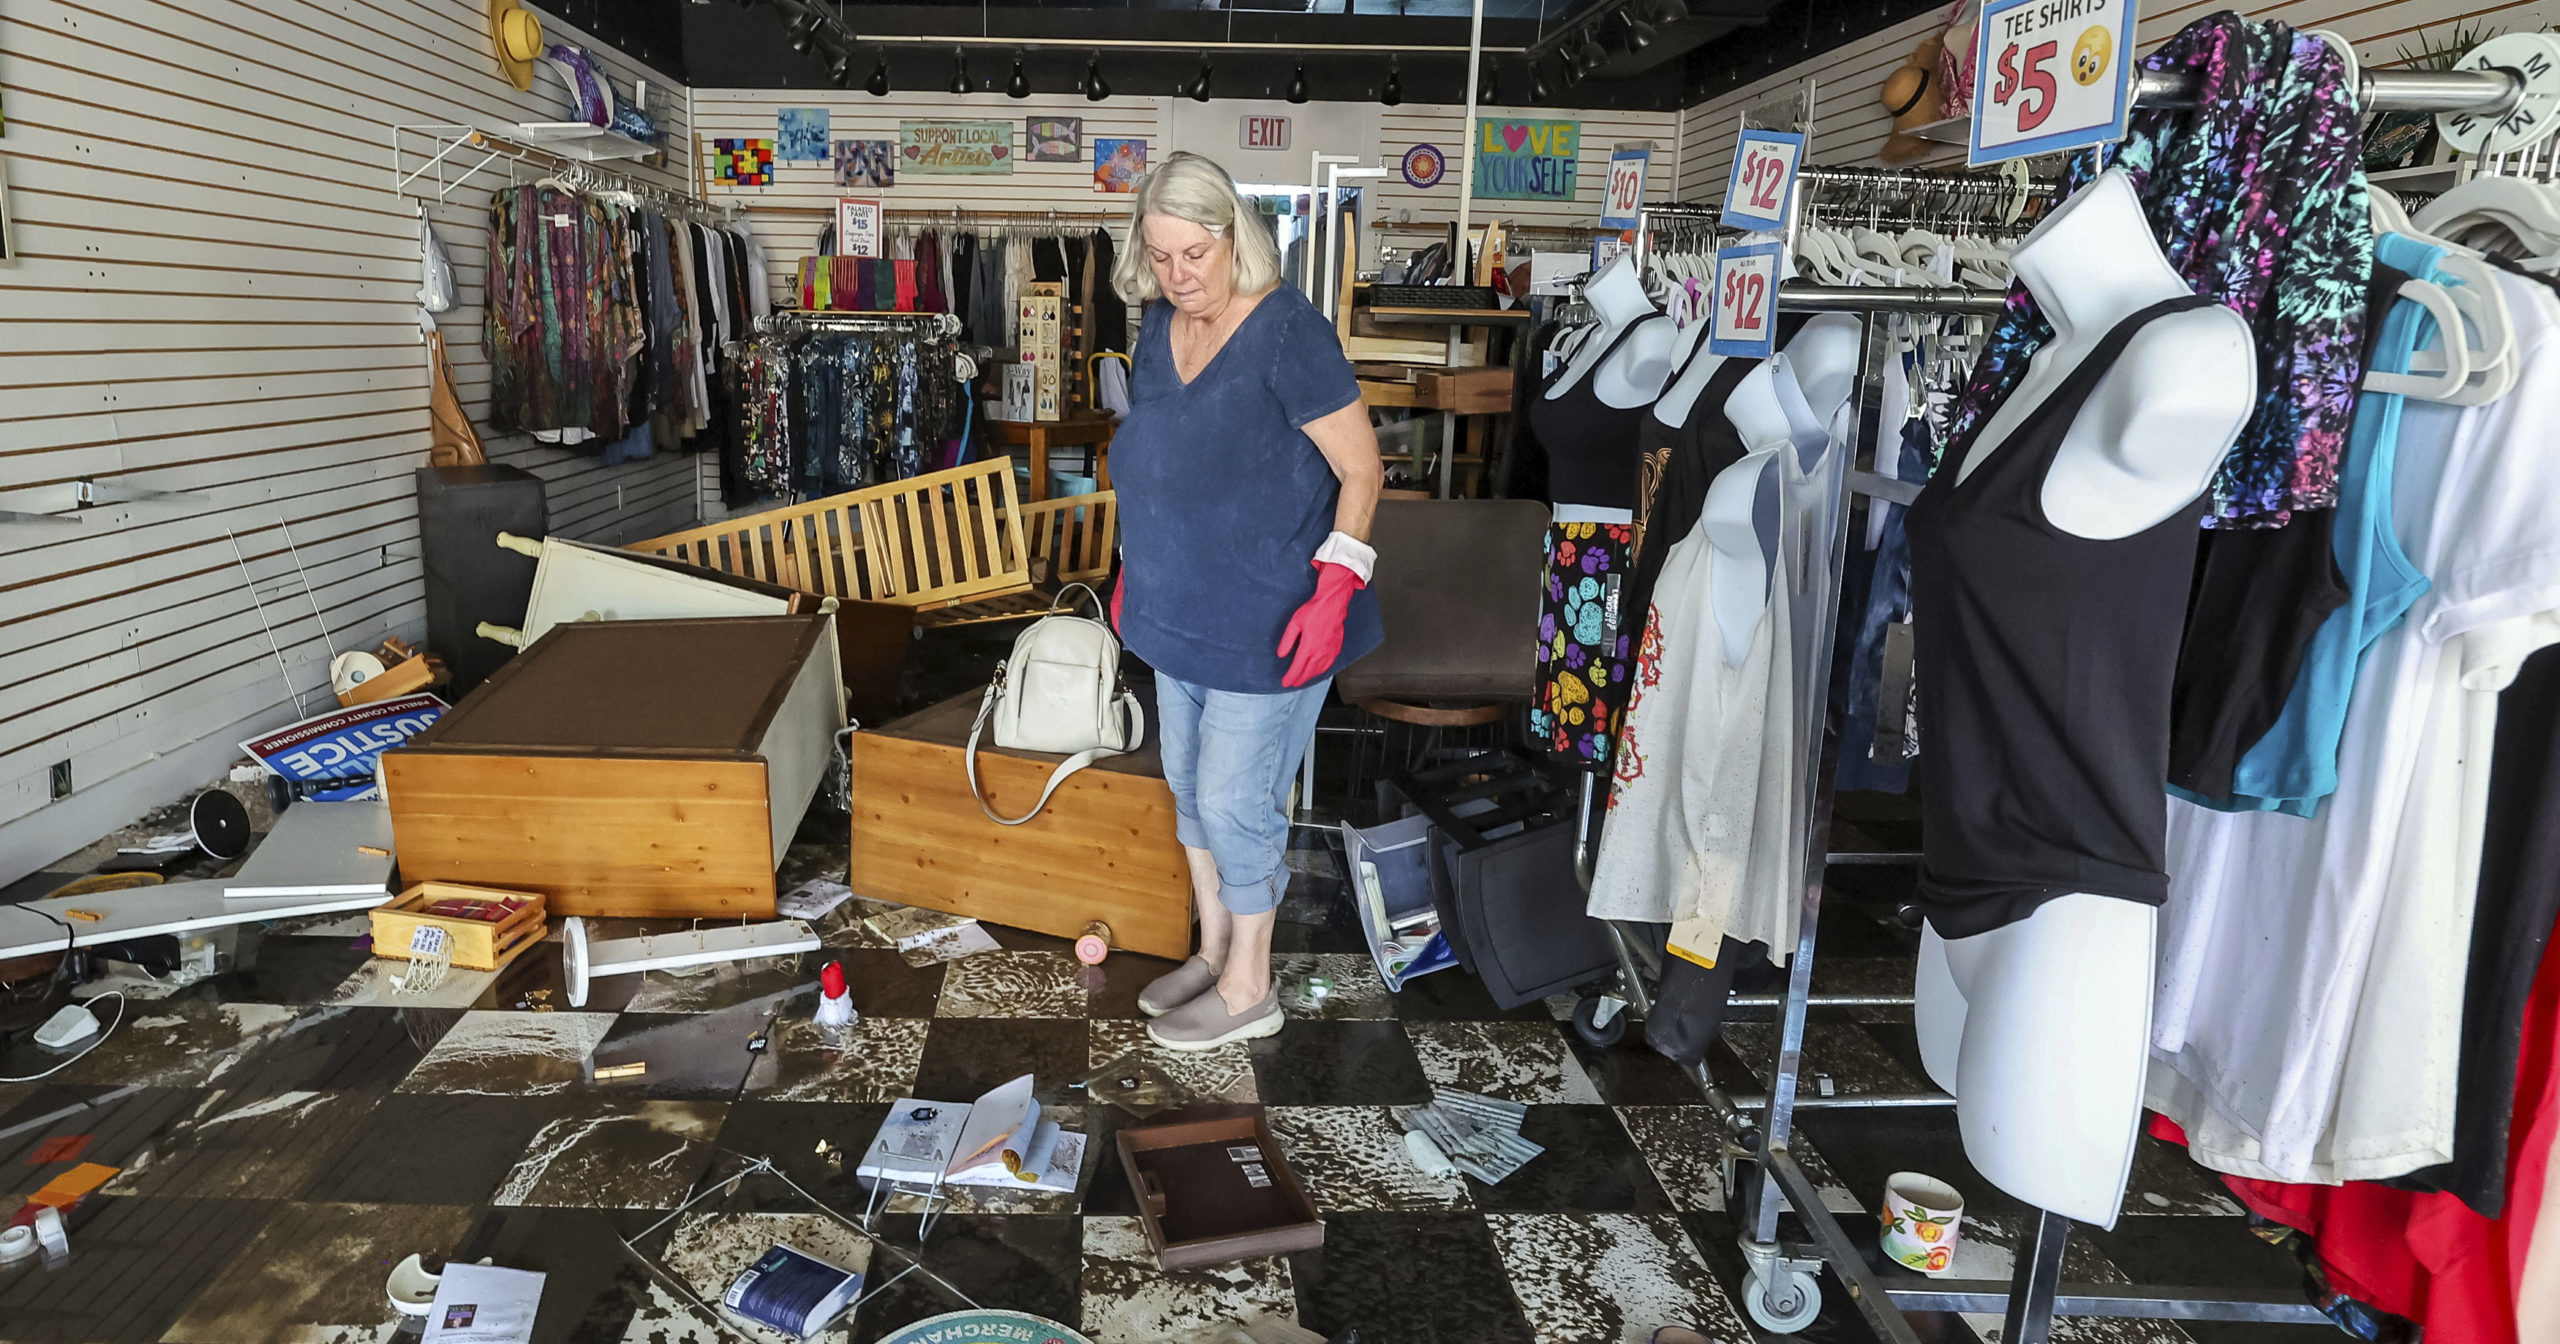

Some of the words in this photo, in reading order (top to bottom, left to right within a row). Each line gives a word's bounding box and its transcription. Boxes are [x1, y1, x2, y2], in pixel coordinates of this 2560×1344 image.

[2004, 9, 2035, 39] TEE
[1994, 40, 2057, 133] $5
[913, 127, 964, 144] SUPPORT
[966, 128, 1002, 145] LOCAL
[1248, 117, 1285, 147] EXIT
[918, 143, 994, 168] Artists
[1611, 167, 1638, 211] $10
[1742, 149, 1784, 210] $12
[852, 217, 868, 230] $15
[852, 243, 869, 256] $12
[1724, 268, 1764, 330] $12
[347, 708, 387, 726] COUNTY
[263, 717, 346, 751] COMMISSIONER
[281, 713, 438, 777] JUSTICE
